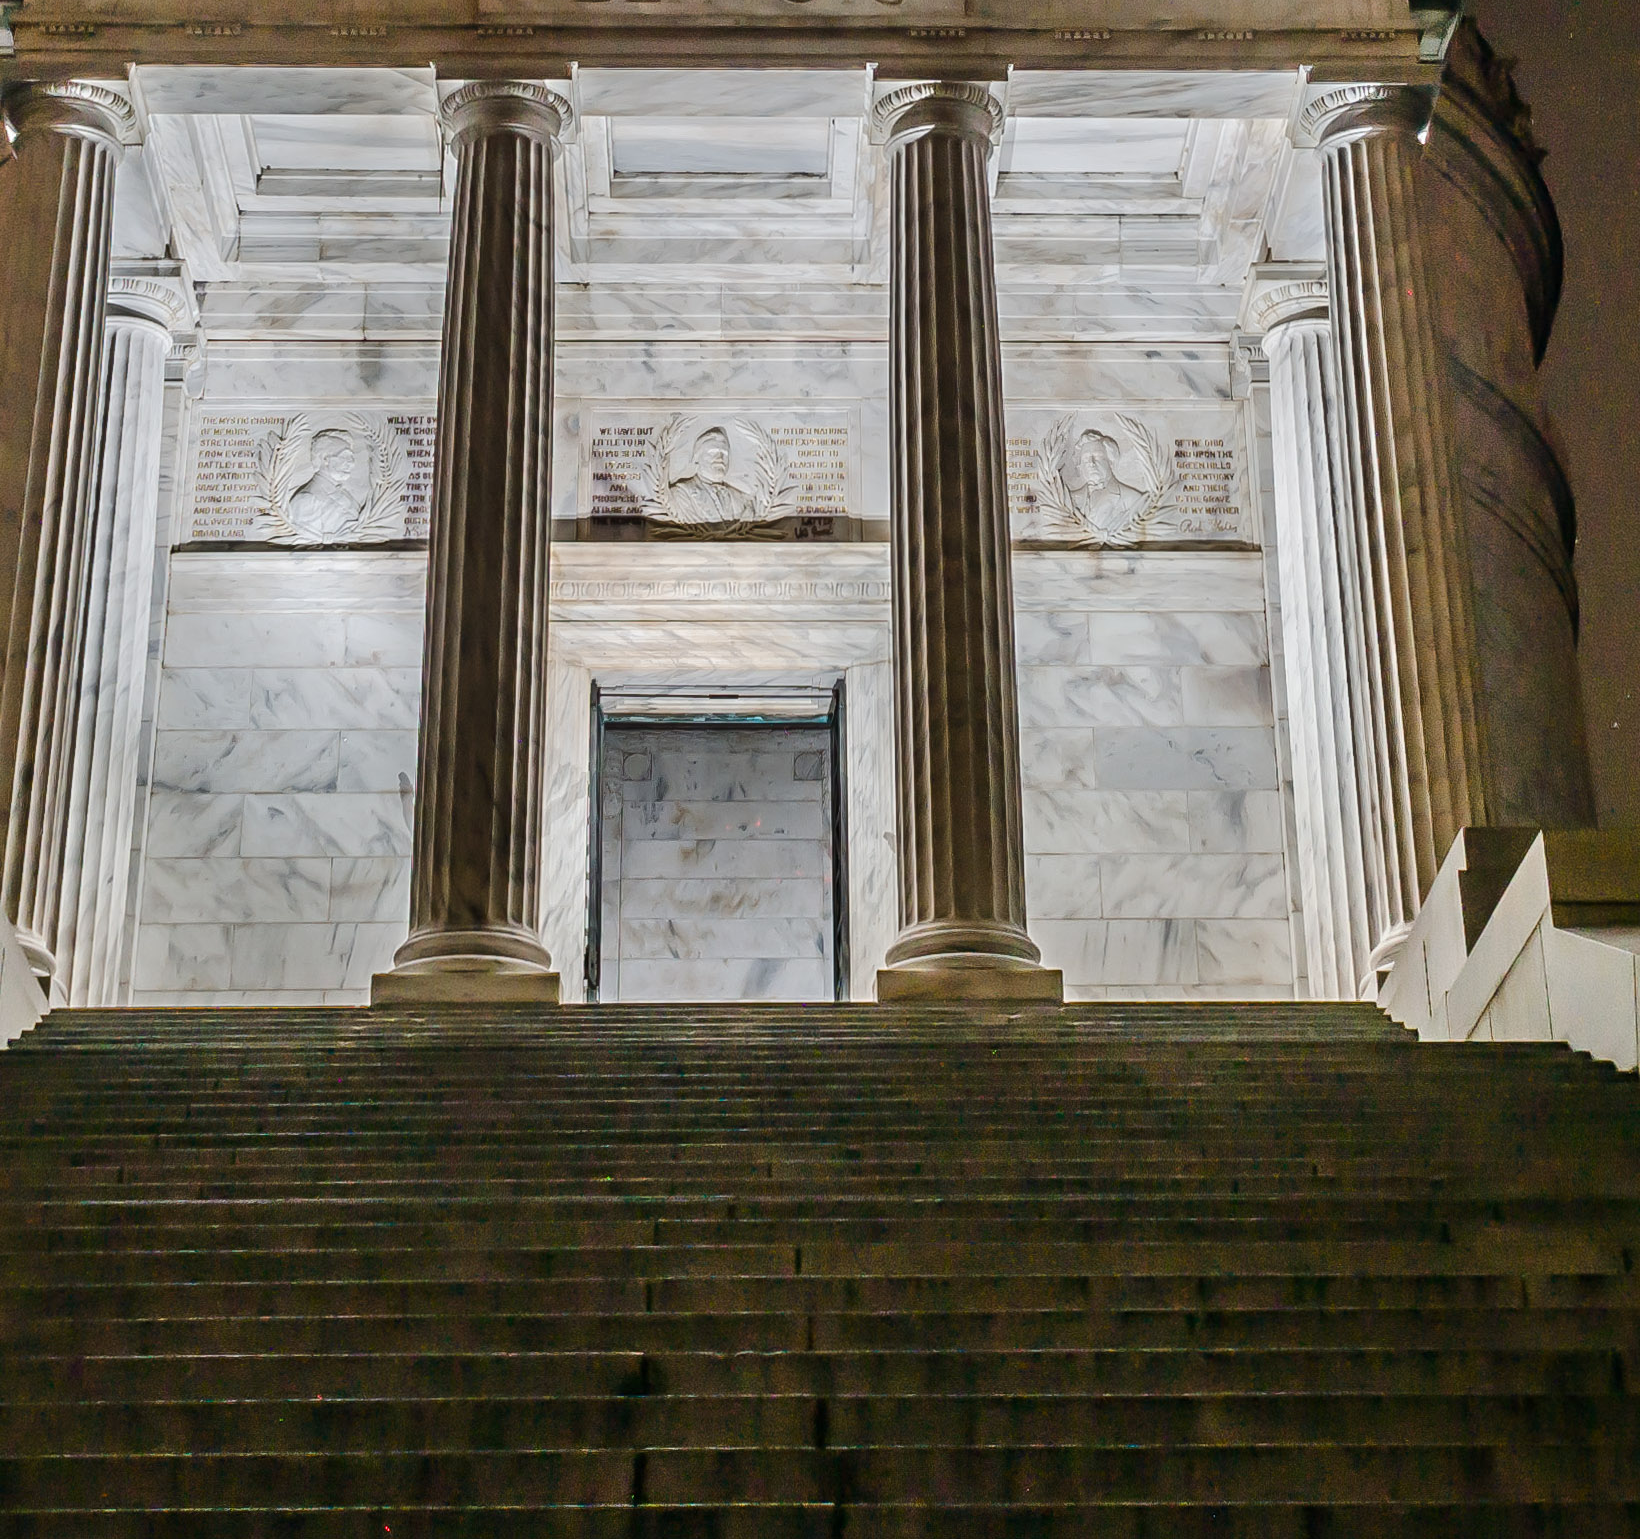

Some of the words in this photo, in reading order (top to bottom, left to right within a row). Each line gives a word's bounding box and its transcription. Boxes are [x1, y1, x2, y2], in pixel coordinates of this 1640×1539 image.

[387, 416, 406, 424] WILL
[407, 416, 424, 424] YET
[395, 427, 411, 435] THE
[599, 427, 612, 435] WE
[199, 450, 223, 458] FROM
[225, 450, 256, 458] EVERY
[197, 472, 214, 480] AND
[406, 483, 429, 491] THEY
[193, 518, 209, 526] ALL
